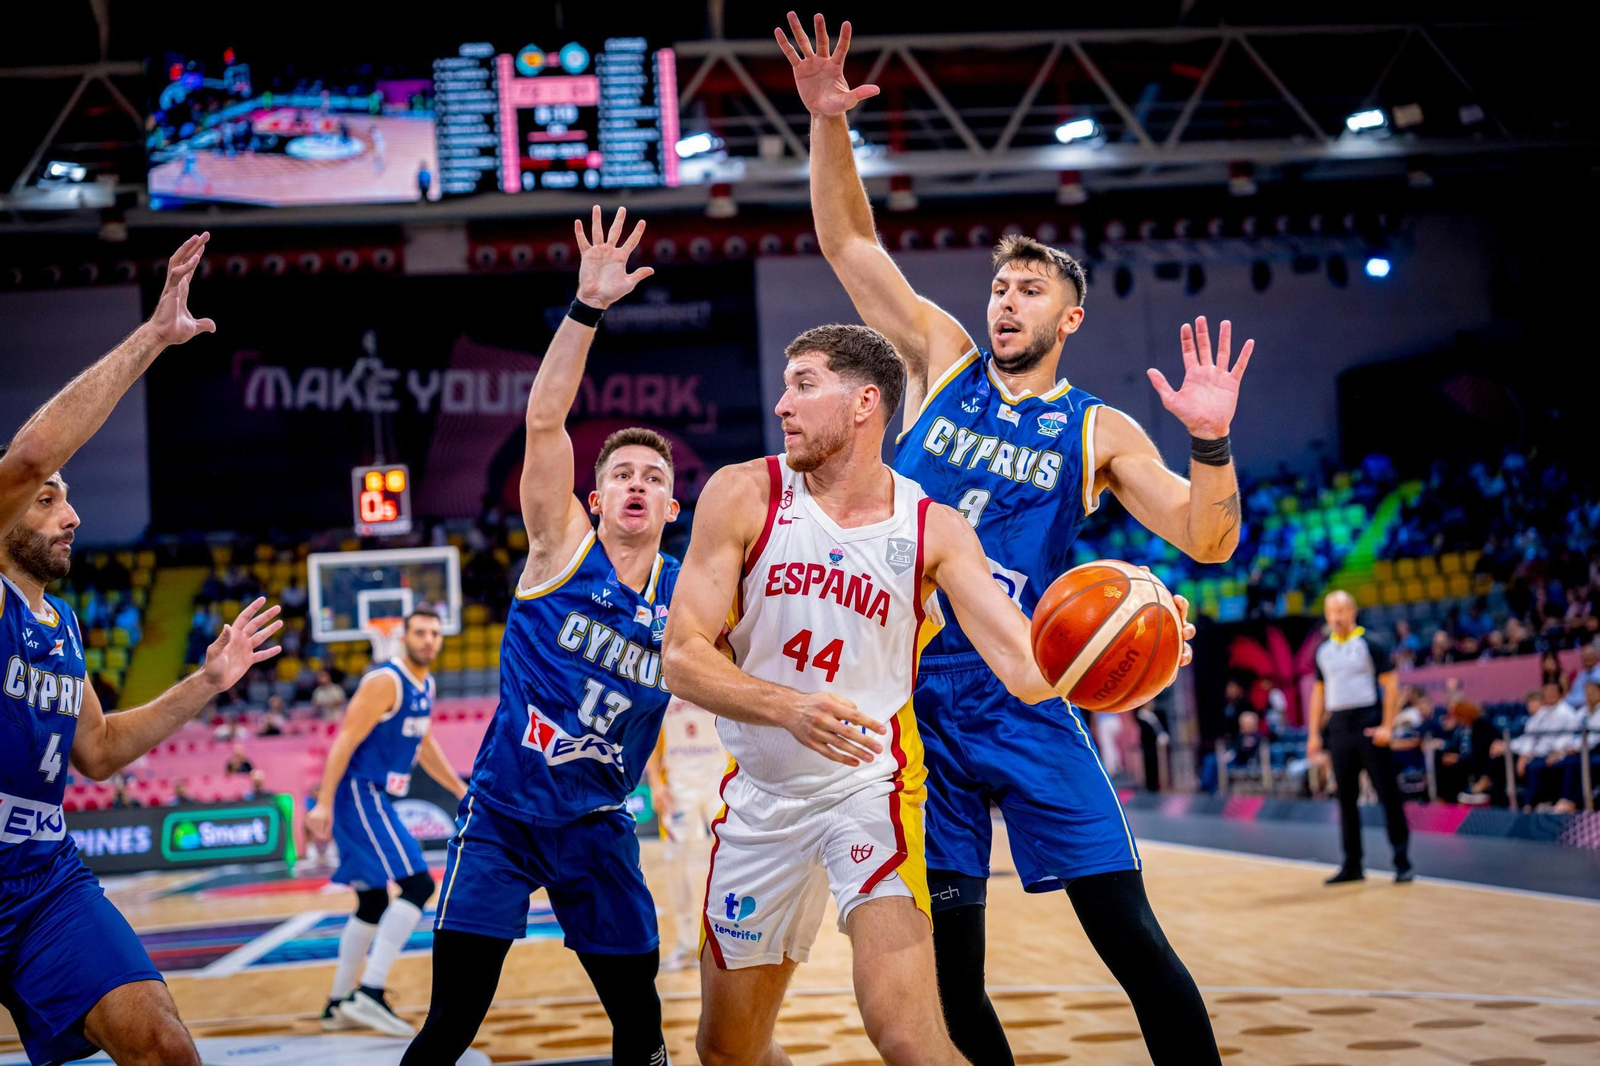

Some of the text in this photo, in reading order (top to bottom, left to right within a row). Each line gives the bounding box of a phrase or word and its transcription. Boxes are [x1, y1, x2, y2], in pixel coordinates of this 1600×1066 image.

[245, 366, 399, 412] MAKE
[923, 416, 1063, 491] CYPRUS
[957, 488, 991, 529] 9
[765, 562, 891, 627] ESPAÑA
[783, 629, 844, 682] 44
[1092, 649, 1140, 702] molten
[577, 678, 632, 736] 13
[39, 733, 62, 783] 4
[199, 817, 267, 847] Smart
